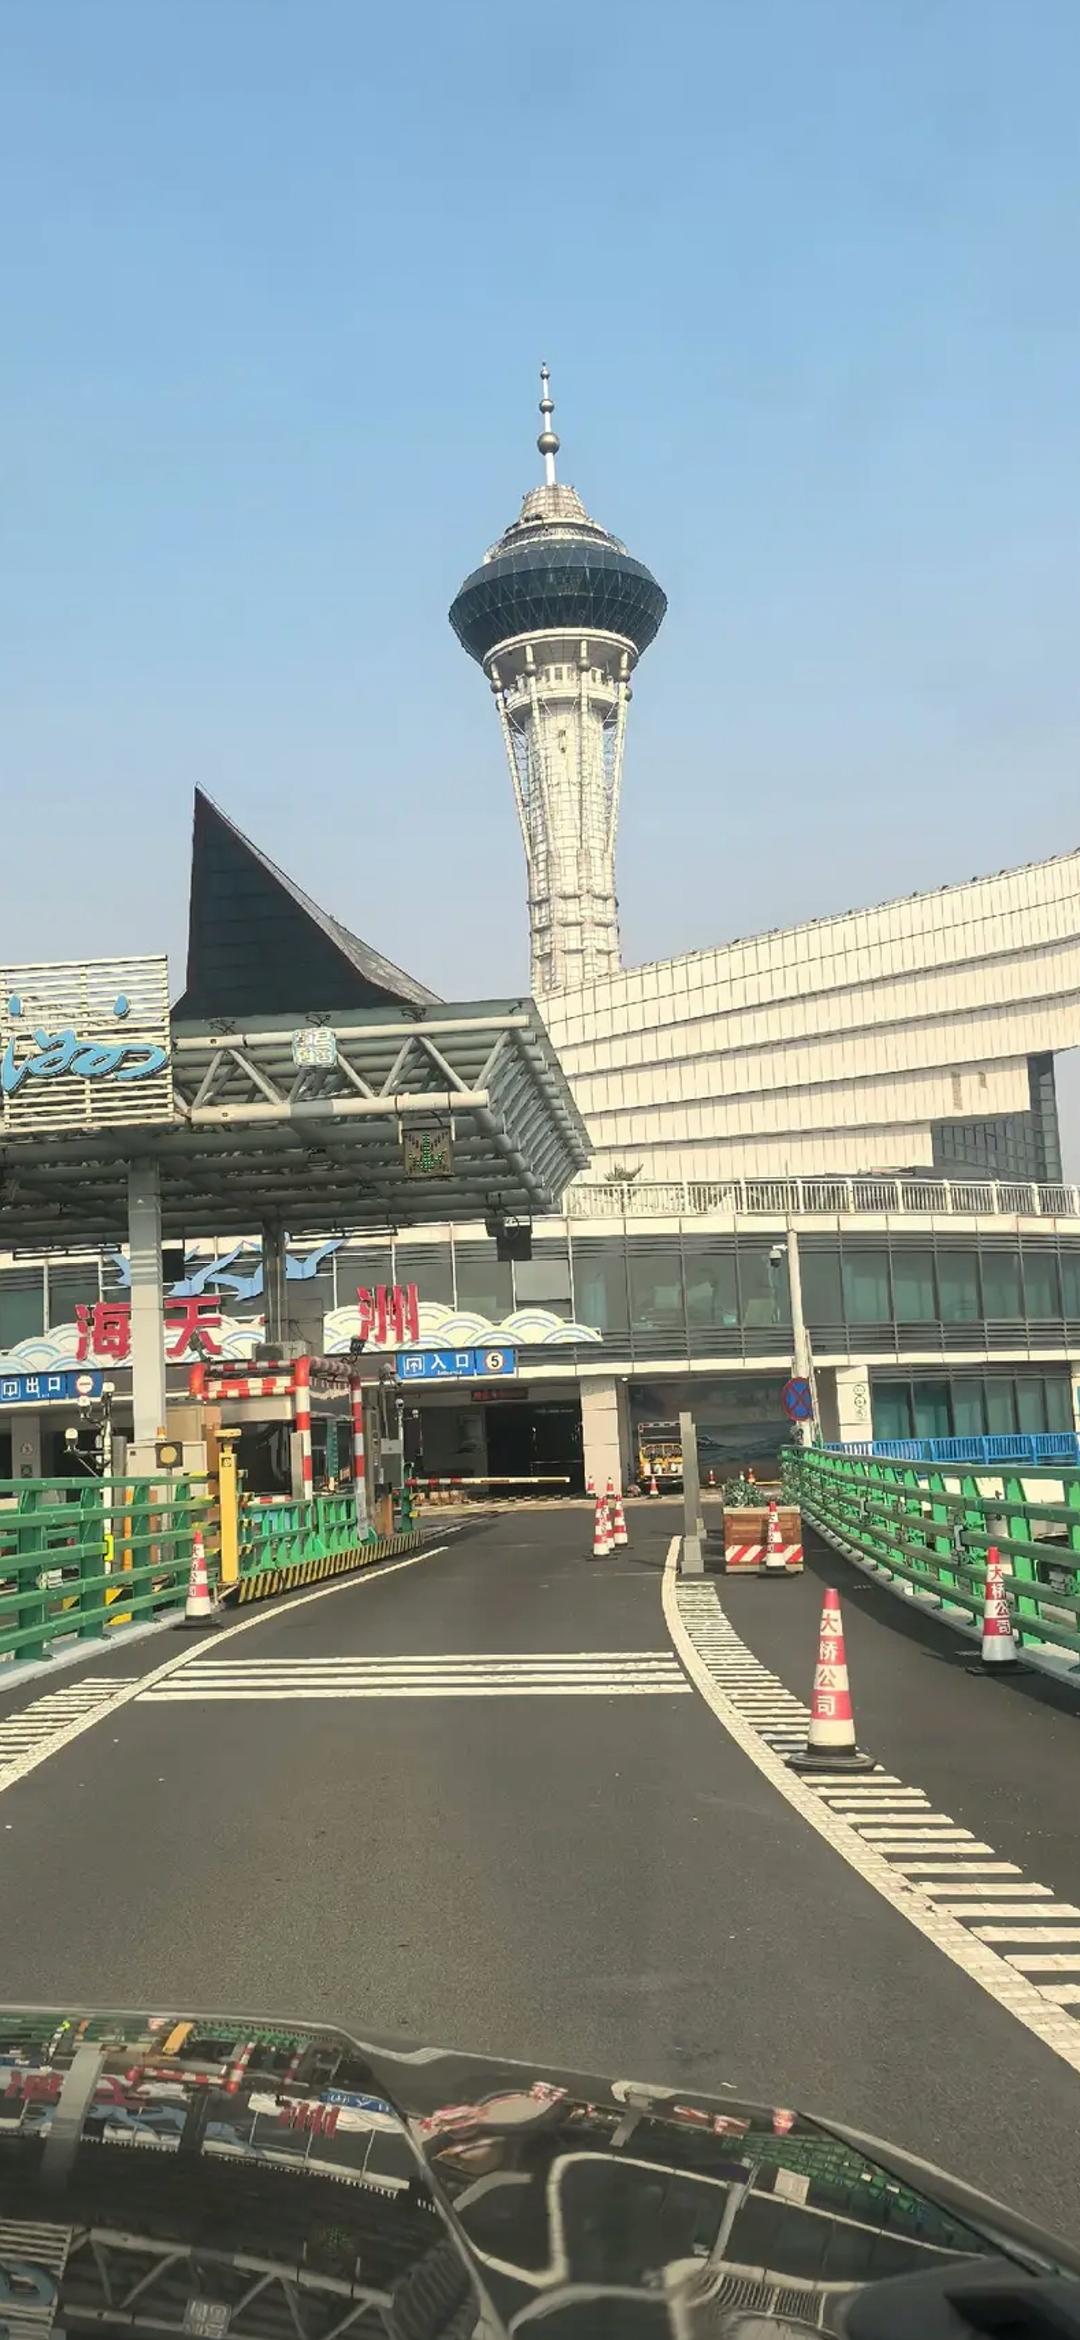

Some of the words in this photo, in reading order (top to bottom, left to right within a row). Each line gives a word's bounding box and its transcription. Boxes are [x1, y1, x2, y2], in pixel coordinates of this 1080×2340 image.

[431, 1354, 468, 1369] 入口
[491, 1354, 500, 1368] 5
[26, 1377, 60, 1394] 出口
[990, 1565, 1011, 1634] 大桥公司
[816, 1612, 839, 1716] 大桥公司
